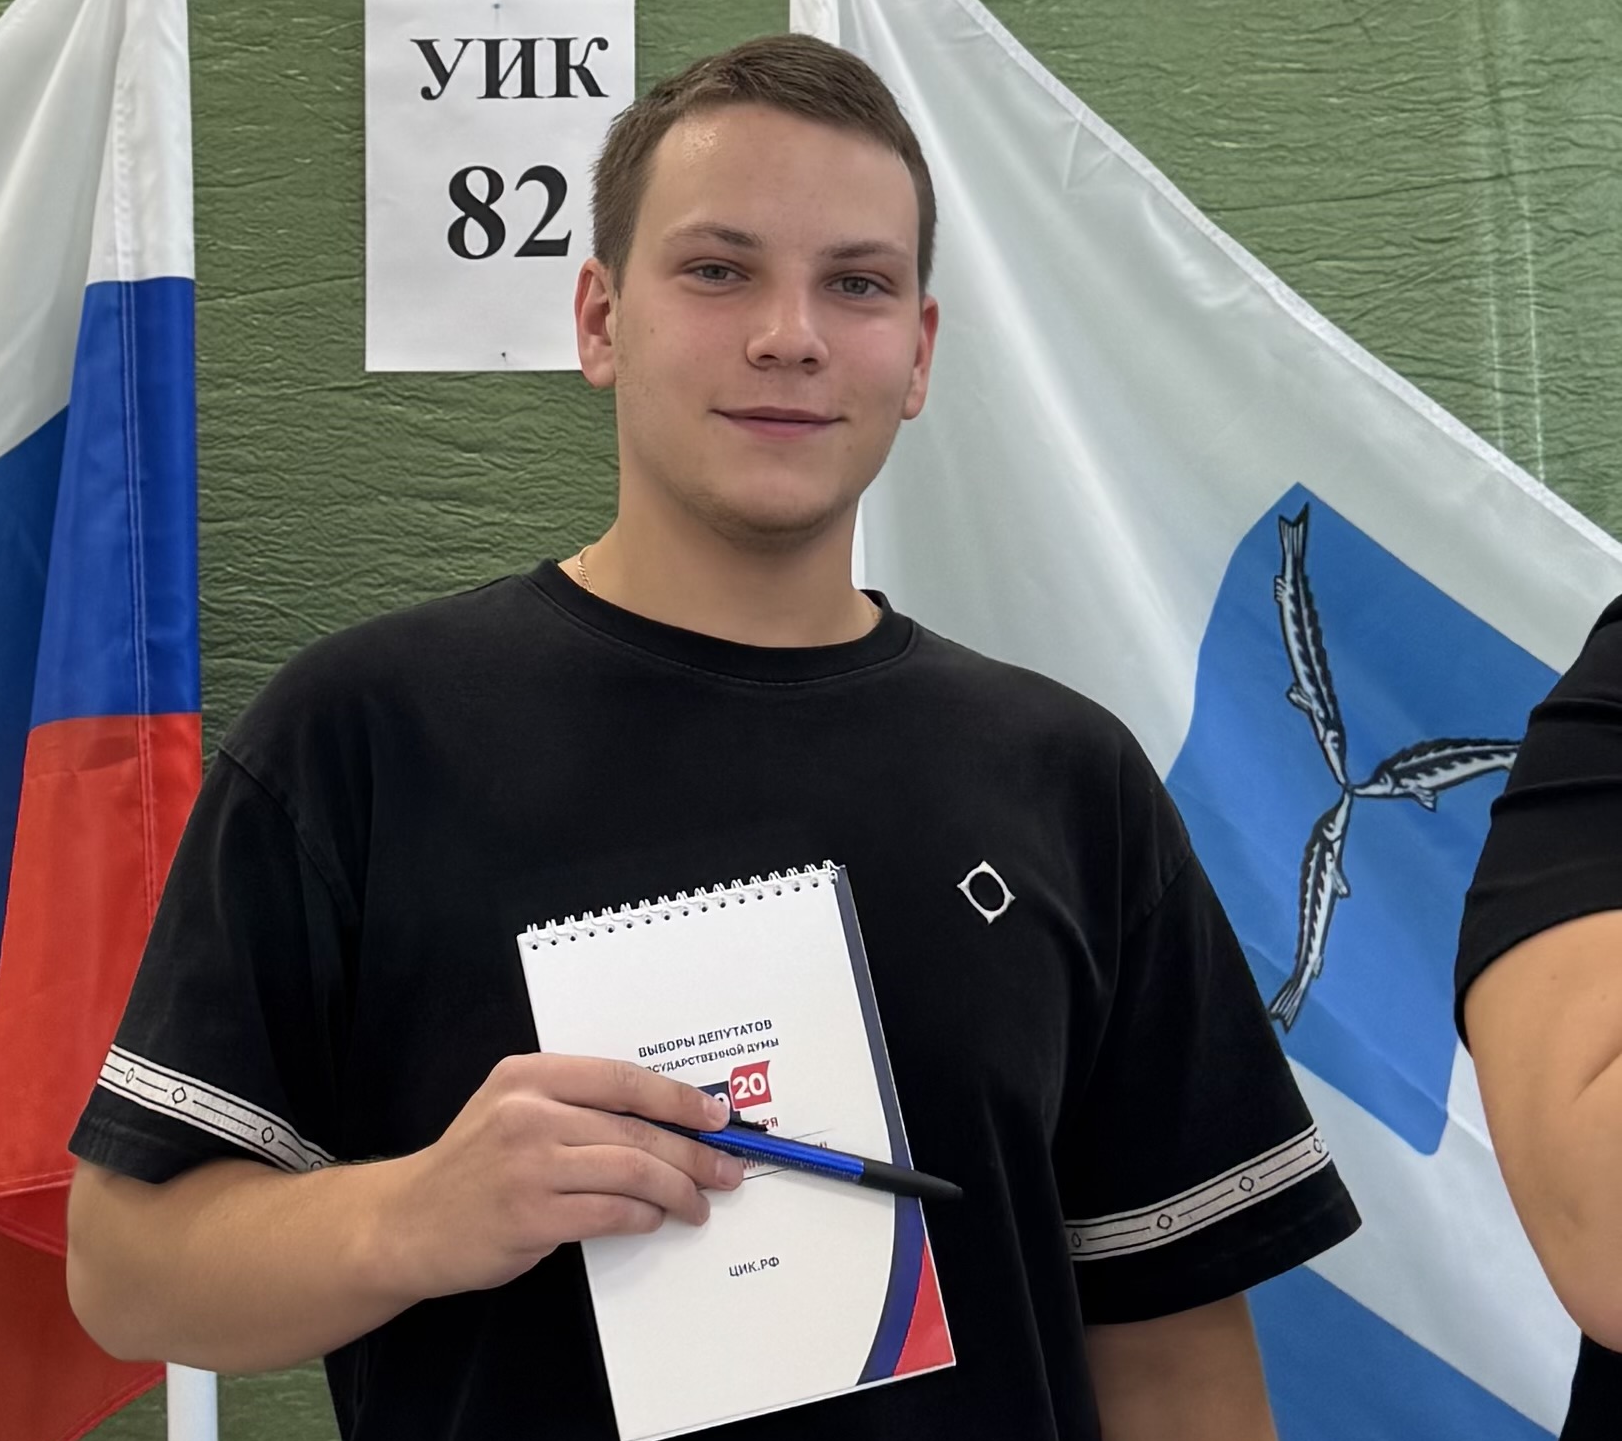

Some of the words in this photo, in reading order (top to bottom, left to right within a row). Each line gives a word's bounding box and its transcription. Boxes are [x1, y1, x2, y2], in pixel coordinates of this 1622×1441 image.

[410, 37, 609, 100] УИК
[447, 165, 572, 259] 82
[638, 1038, 695, 1058] ВЫБОРЫ
[699, 1019, 772, 1046] ДЕПУТАТОВ
[644, 1044, 745, 1073] СУДАРСТВЕННОЙ
[746, 1038, 779, 1054] ДУМЫ
[729, 1256, 779, 1277] ЦИК.РФ
